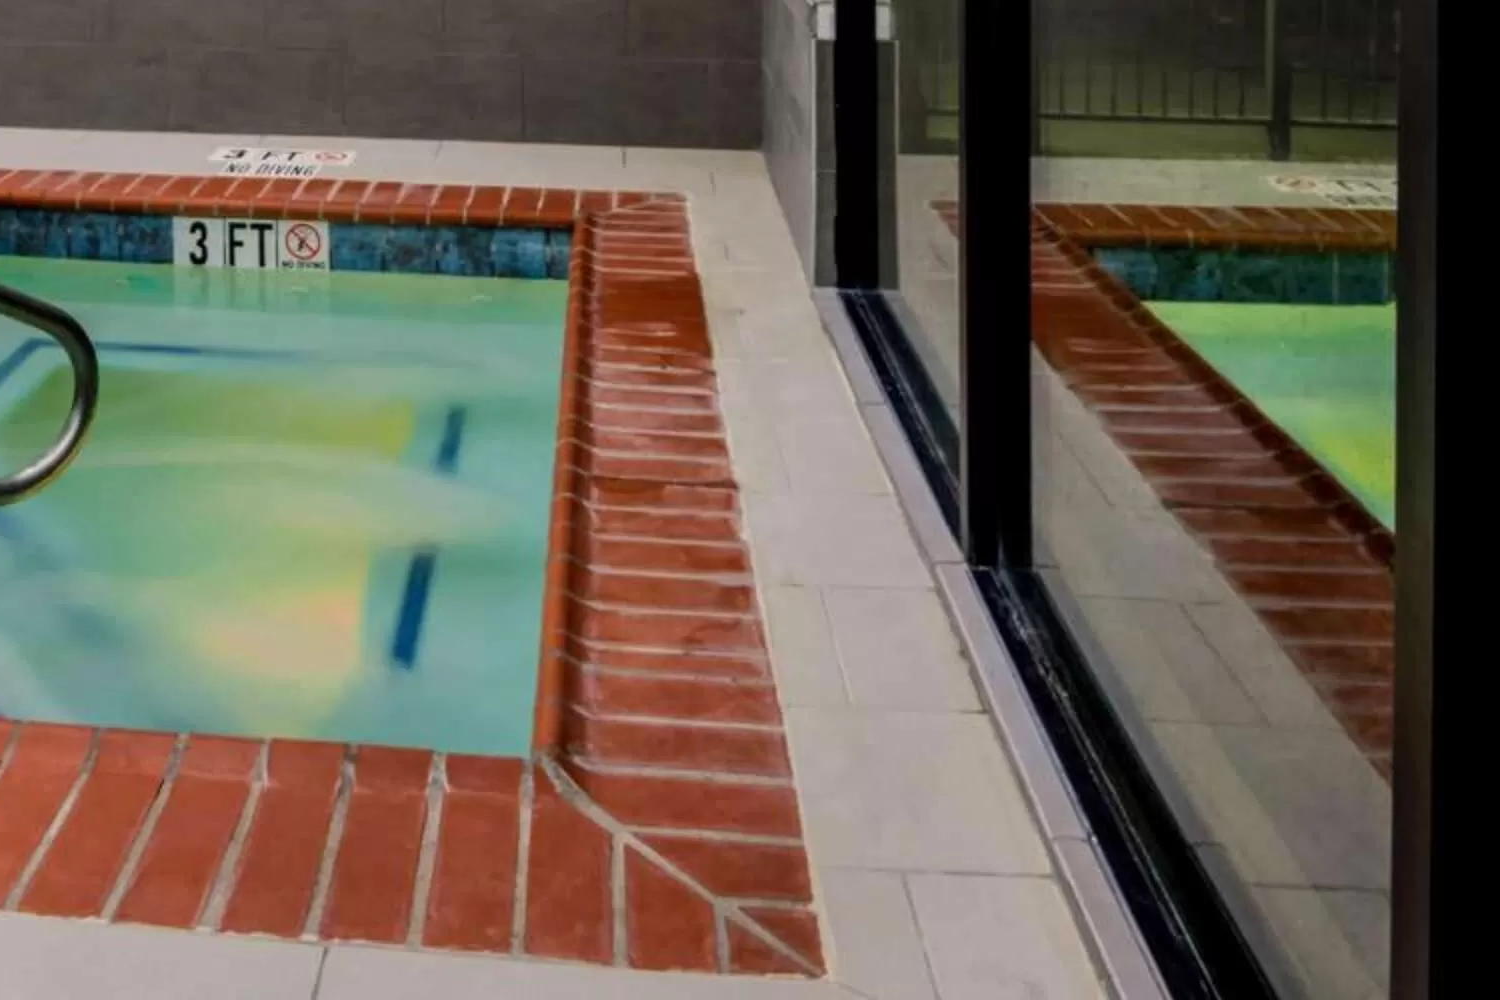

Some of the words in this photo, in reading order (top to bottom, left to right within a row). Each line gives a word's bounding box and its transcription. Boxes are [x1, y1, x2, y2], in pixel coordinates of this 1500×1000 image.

[225, 163, 251, 174] NO
[256, 164, 317, 176] DIVING
[189, 221, 208, 265] 3
[228, 222, 273, 267] FT
